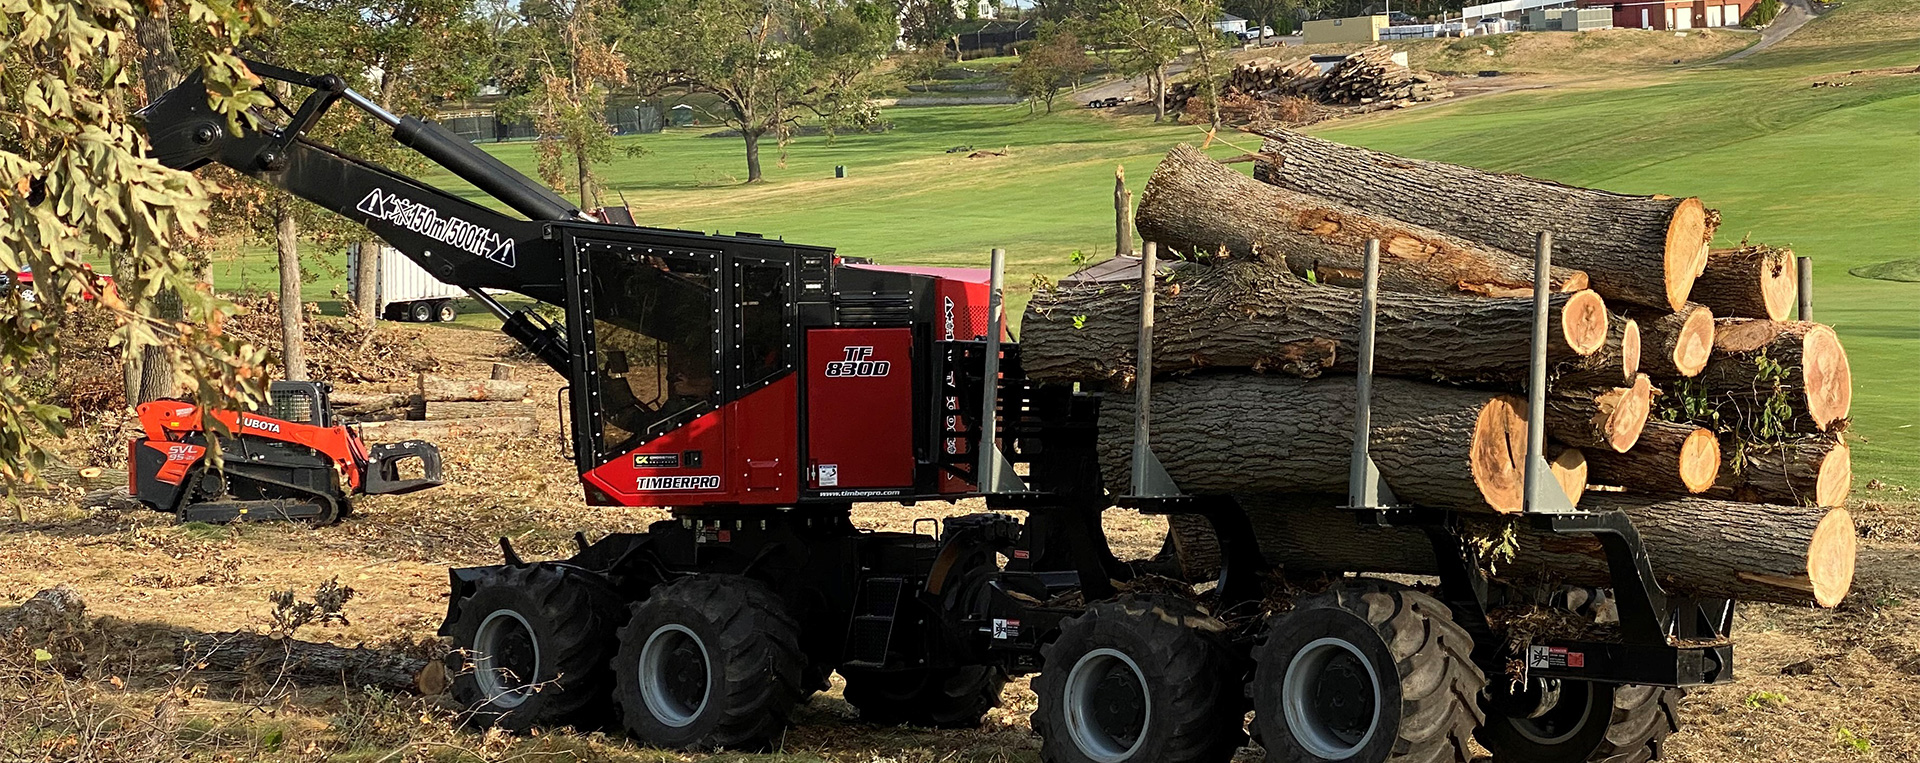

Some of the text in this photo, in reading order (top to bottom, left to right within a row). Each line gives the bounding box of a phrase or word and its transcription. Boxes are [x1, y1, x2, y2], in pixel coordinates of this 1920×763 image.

[408, 203, 490, 256] 150m/500ft
[843, 346, 873, 362] TF
[168, 445, 198, 454] SVL
[636, 475, 720, 490] TIMBERPRO
